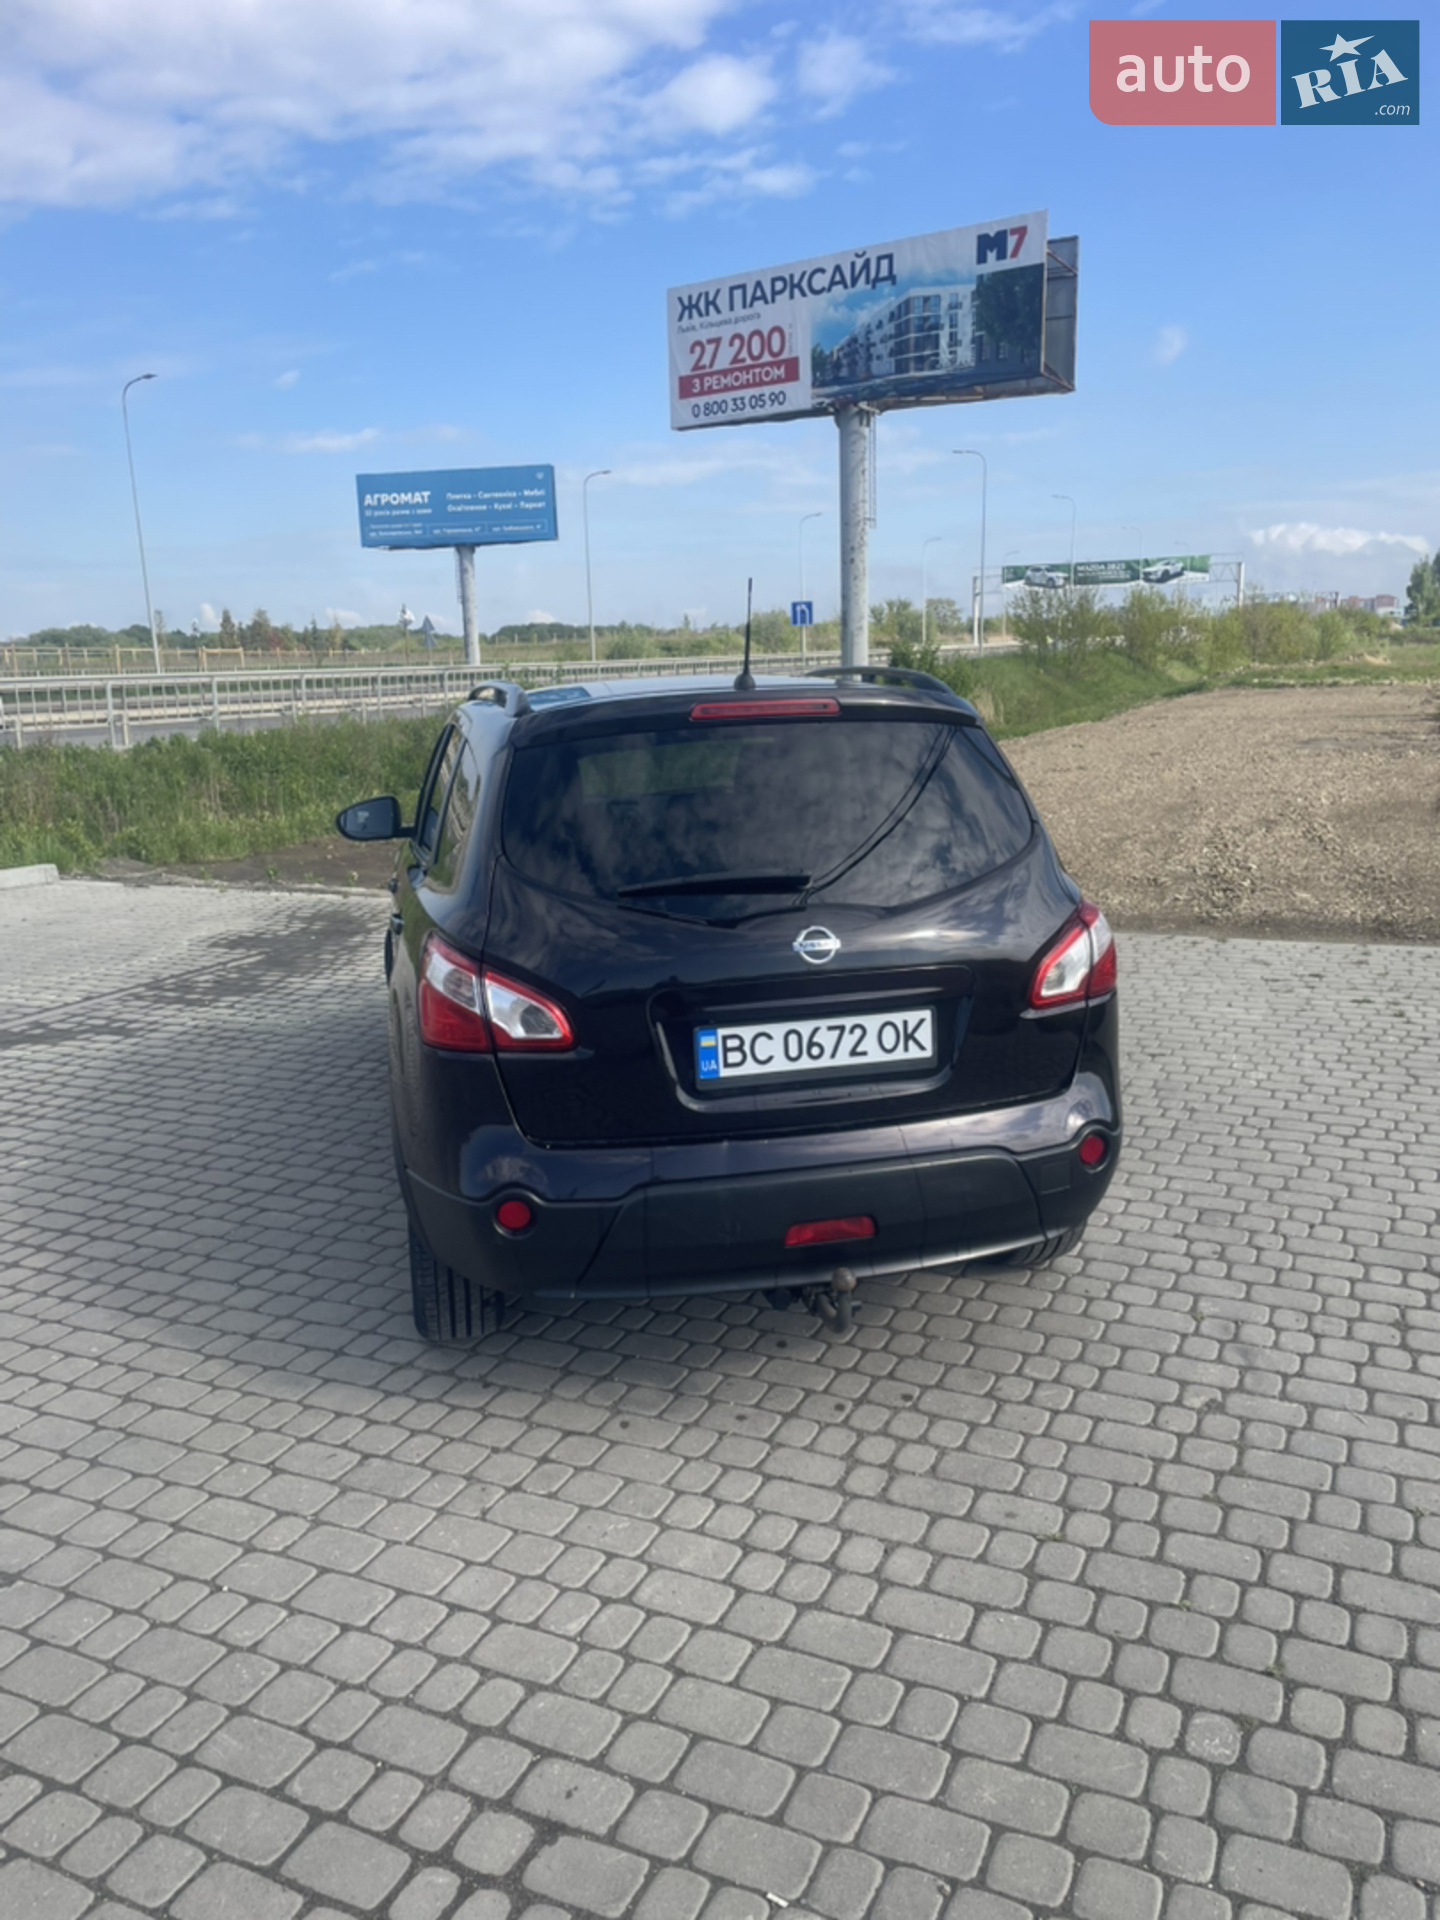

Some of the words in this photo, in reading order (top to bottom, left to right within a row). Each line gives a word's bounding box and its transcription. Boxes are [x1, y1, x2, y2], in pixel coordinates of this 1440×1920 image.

[677, 287, 722, 322] ЖК
[728, 251, 897, 312] ПАРКСАЙД
[734, 312, 762, 325] дорога
[689, 336, 723, 373] 27
[728, 325, 787, 366] 200
[703, 364, 786, 392] РЕМОНТОМ
[691, 403, 701, 418] 0
[703, 399, 729, 417] 800
[730, 396, 747, 413] 33
[749, 393, 766, 410] 05
[768, 390, 787, 407] 90
[363, 491, 431, 506] АГРОМАТ
[721, 1031, 775, 1069] BC
[783, 1023, 868, 1063] 0672
[877, 1018, 928, 1054] OK
[701, 1060, 717, 1071] UA
